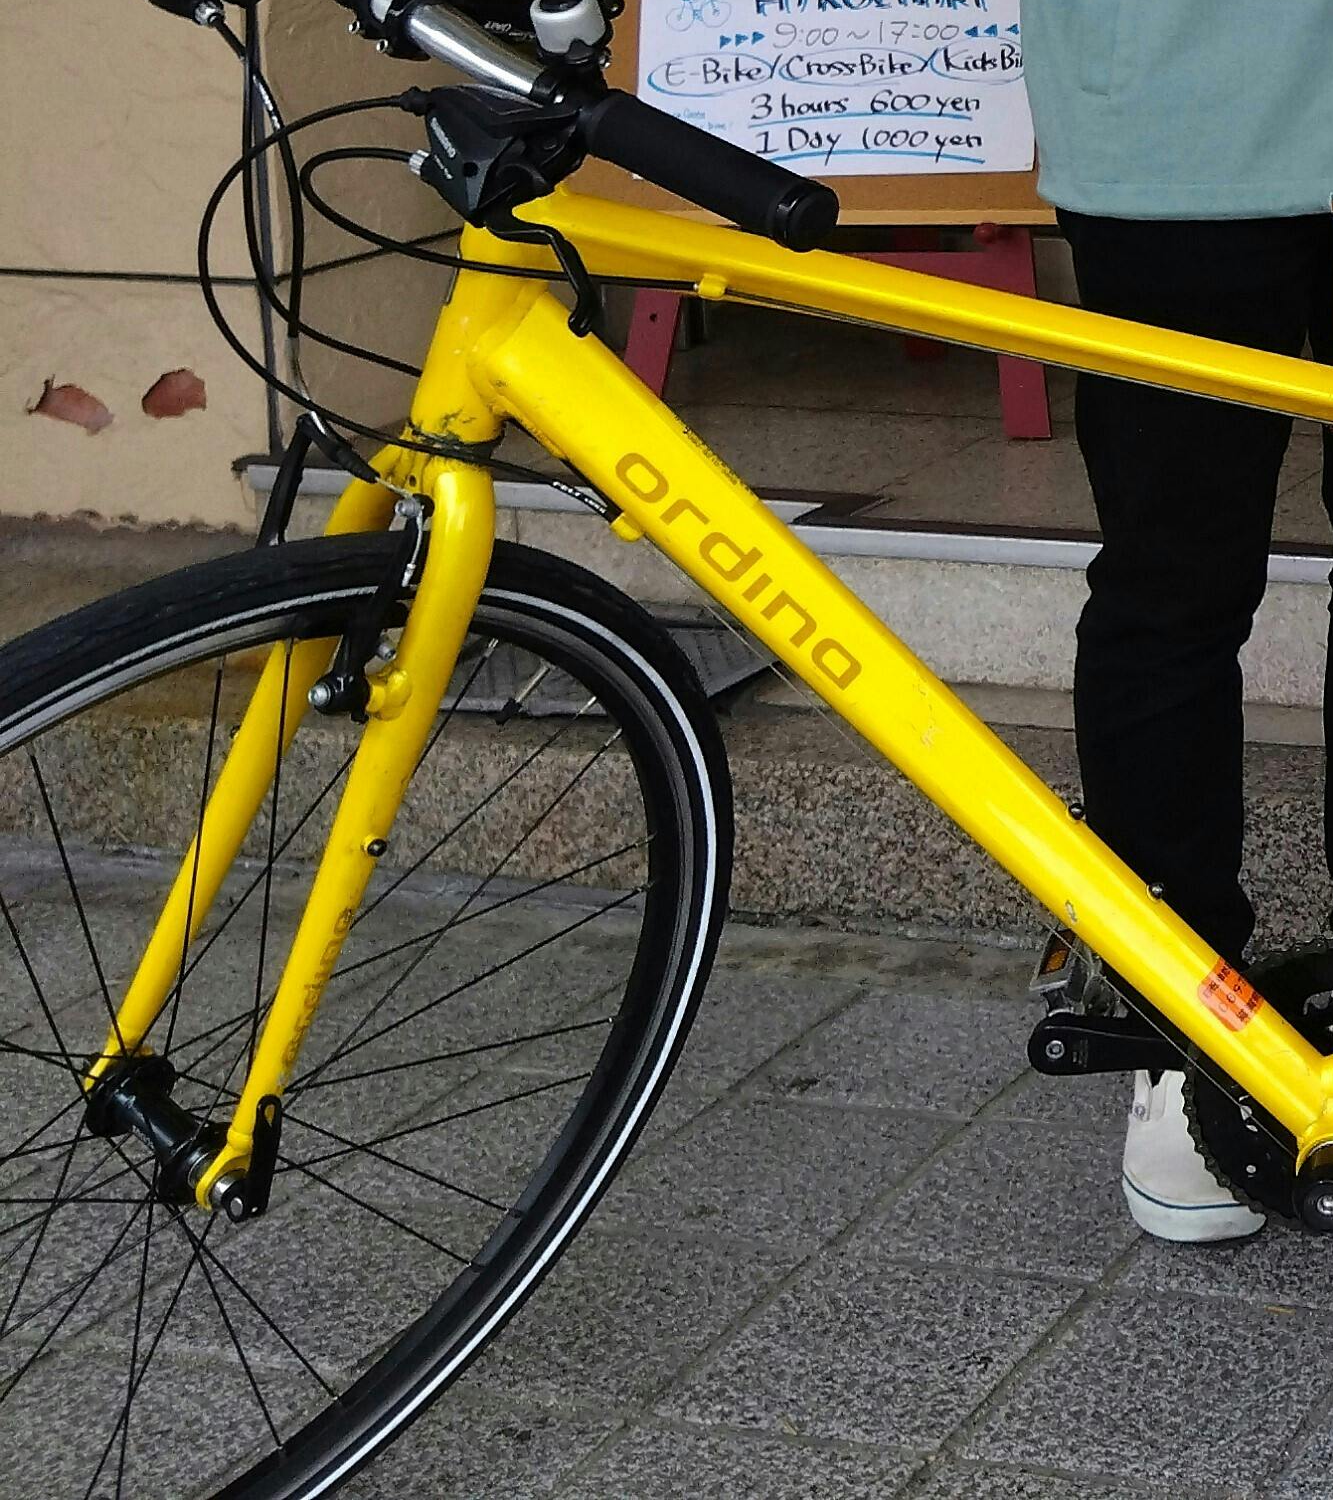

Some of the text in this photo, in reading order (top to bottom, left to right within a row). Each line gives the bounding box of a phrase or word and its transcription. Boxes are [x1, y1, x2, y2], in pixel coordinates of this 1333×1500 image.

[750, 98, 773, 121] 3
[781, 90, 848, 116] hours
[755, 131, 778, 155] 1
[786, 129, 841, 166] Day
[614, 451, 863, 691] ordino
